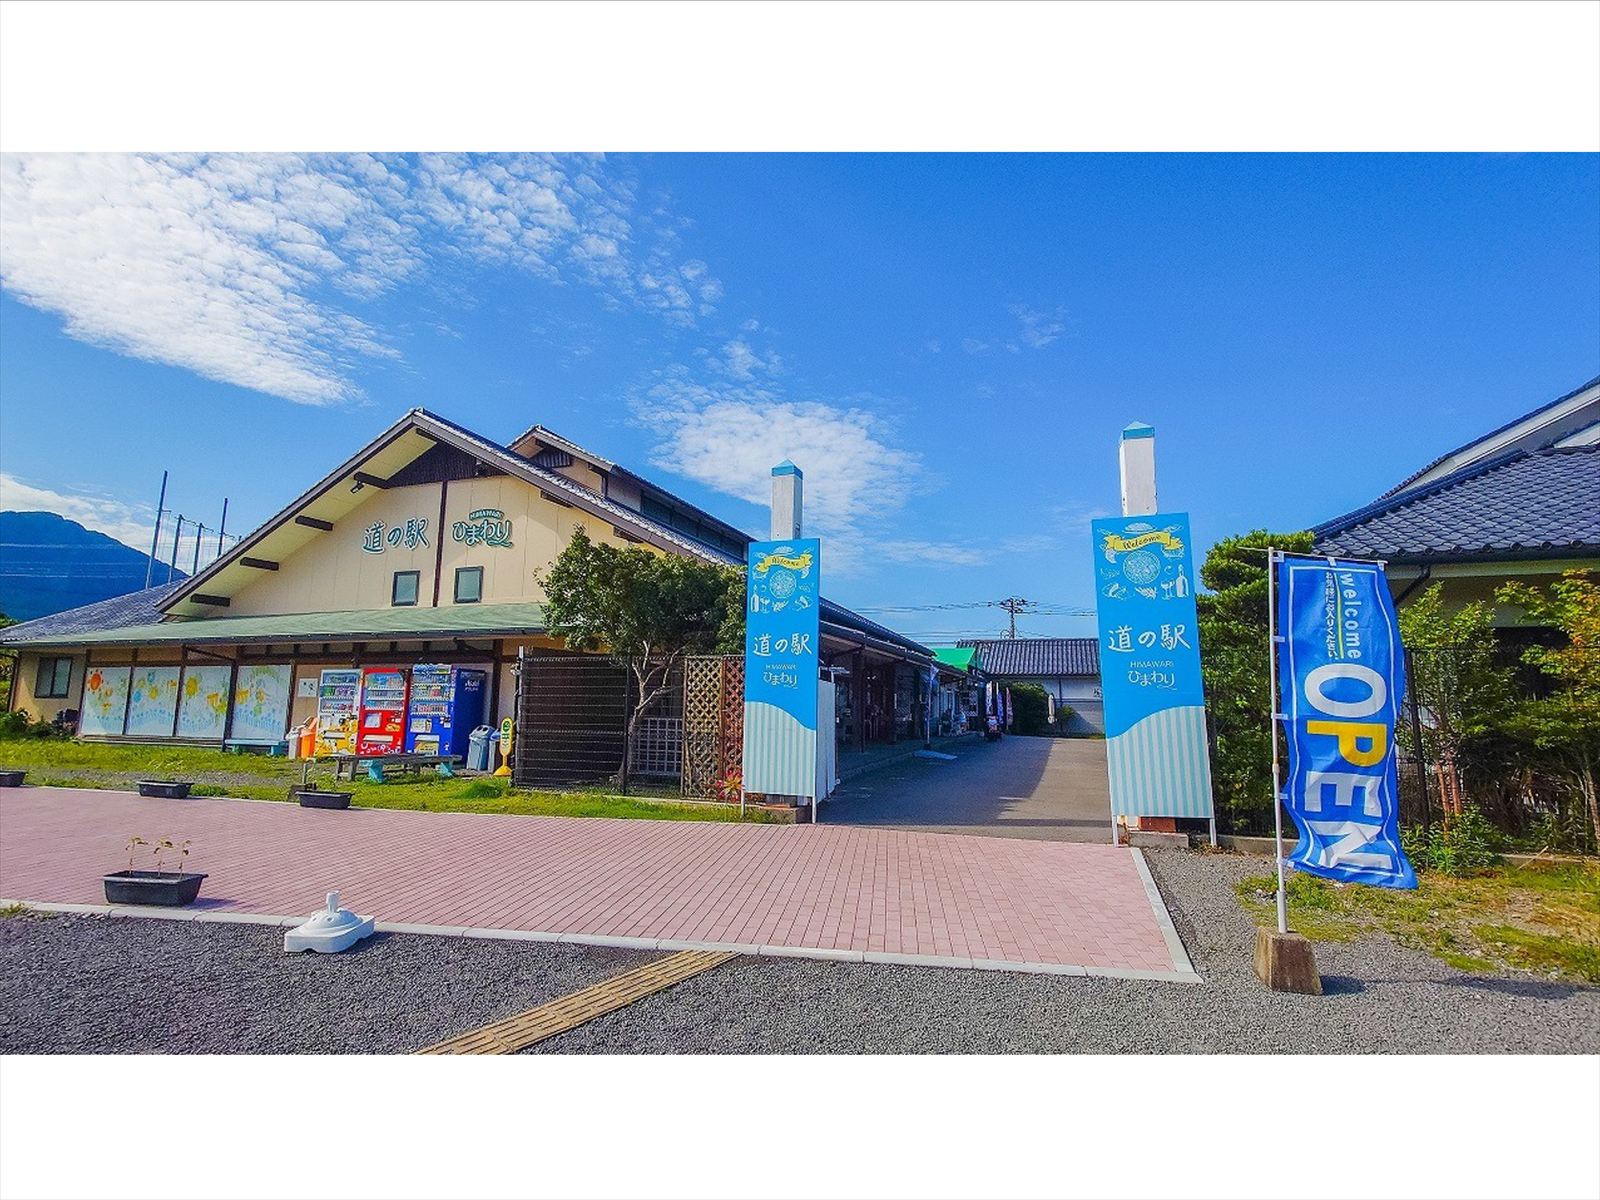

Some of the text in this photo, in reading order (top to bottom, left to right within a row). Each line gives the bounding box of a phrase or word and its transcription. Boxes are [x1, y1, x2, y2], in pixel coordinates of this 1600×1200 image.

[362, 517, 431, 554] 道の駅
[452, 519, 513, 548] ひまわり
[1123, 533, 1161, 550] Welcome
[1340, 573, 1362, 659] welcome
[753, 633, 812, 656] 道の駅
[1108, 624, 1191, 652] 道の駅
[763, 671, 798, 688] ひまわり
[1128, 670, 1177, 691] ひまわり
[1304, 663, 1393, 870] OPEN
